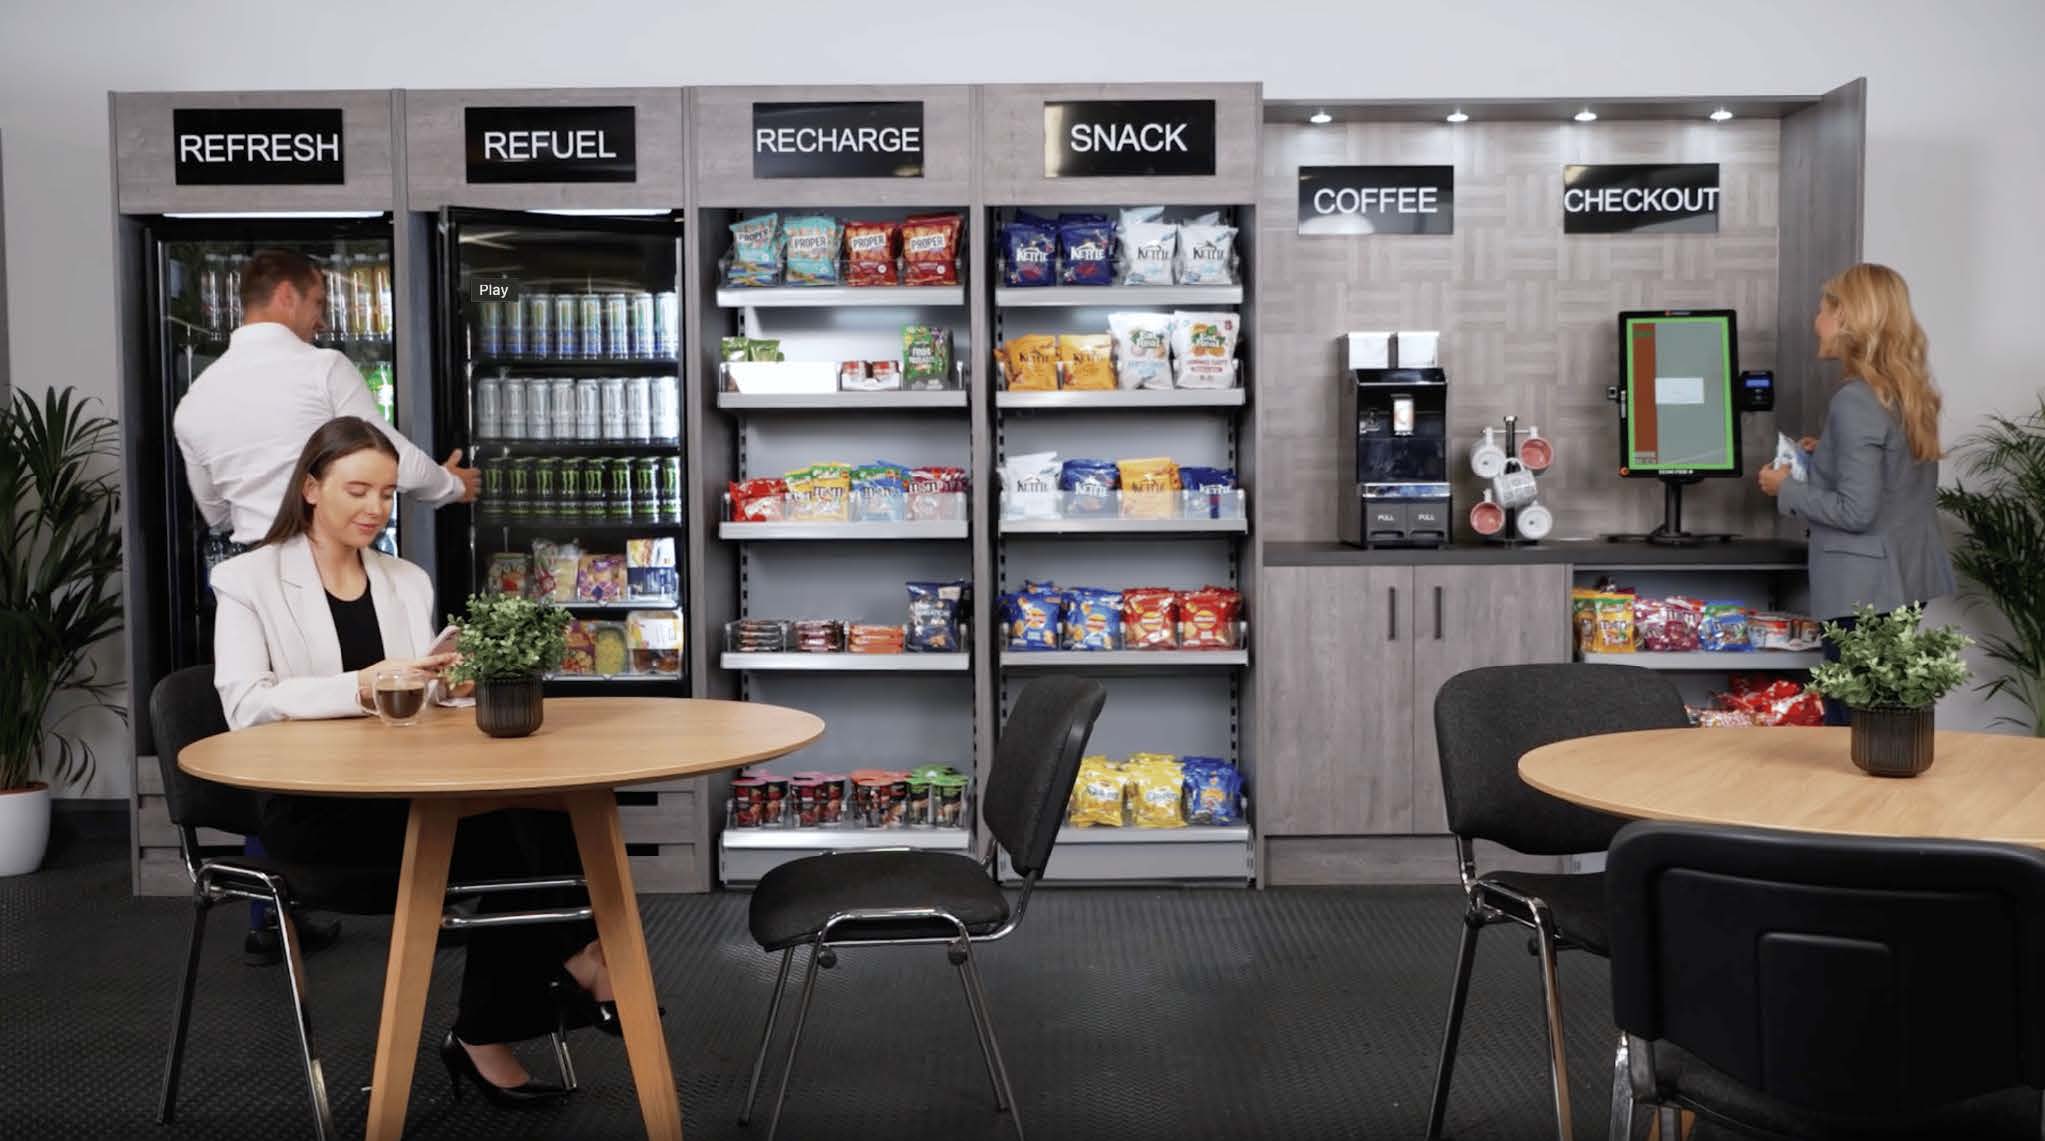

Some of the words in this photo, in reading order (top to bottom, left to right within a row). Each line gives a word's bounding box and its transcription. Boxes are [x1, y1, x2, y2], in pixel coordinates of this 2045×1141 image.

[181, 134, 338, 161] REFRESH
[485, 131, 616, 158] REFUEL
[757, 128, 919, 152] RECHARGE
[1071, 124, 1187, 151] SNACK
[1313, 187, 1439, 214] COFFEE
[1564, 187, 1720, 213] CHECKOUT
[794, 237, 827, 249] PROPER
[853, 235, 885, 248] PROPER
[911, 236, 944, 250] PROPER
